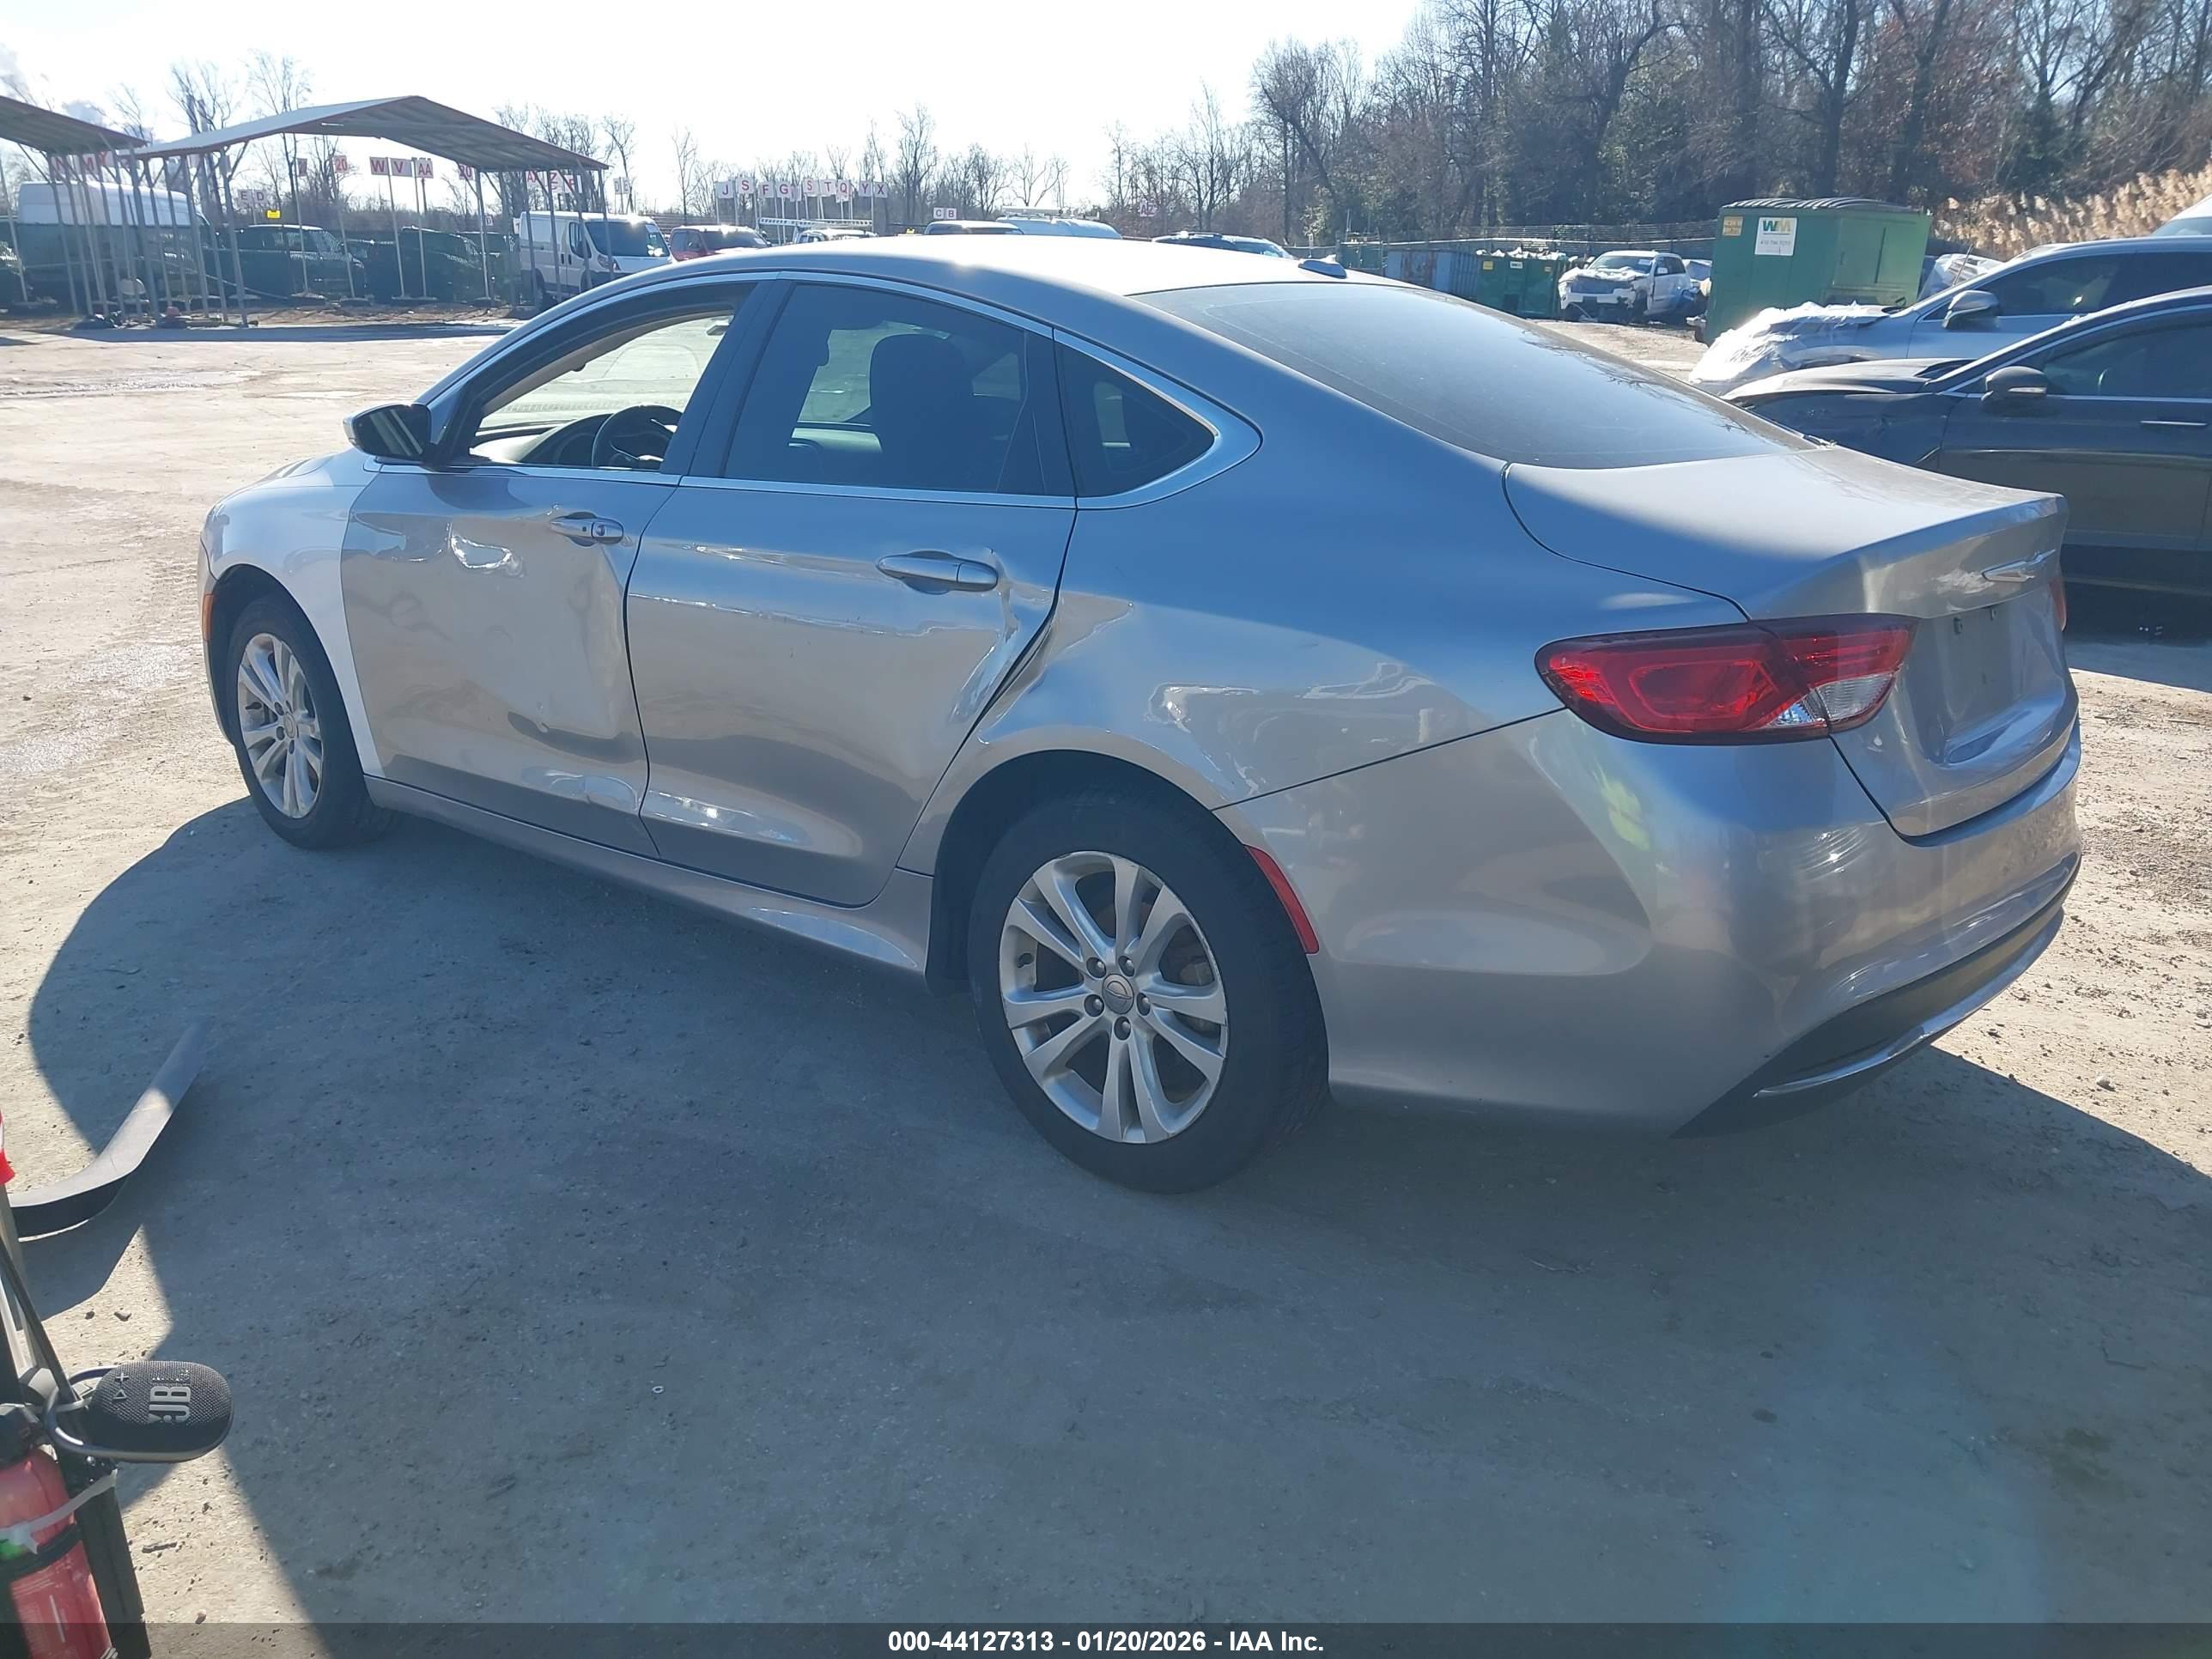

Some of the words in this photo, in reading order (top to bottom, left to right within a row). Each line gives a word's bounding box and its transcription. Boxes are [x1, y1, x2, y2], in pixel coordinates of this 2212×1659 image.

[335, 158, 348, 171] 20
[371, 161, 385, 173] W
[394, 161, 404, 173] V
[418, 163, 433, 176] AA
[722, 185, 729, 196] J
[741, 179, 750, 191] S
[763, 185, 769, 195] F
[779, 184, 789, 195] G
[806, 180, 812, 191] S
[824, 181, 832, 192] T
[840, 182, 848, 193] Q
[861, 183, 869, 194] Y
[878, 183, 884, 195] X
[241, 191, 248, 200] E
[257, 191, 264, 201] D
[936, 209, 942, 217] C
[948, 210, 954, 218] B
[1763, 219, 1791, 232] WM
